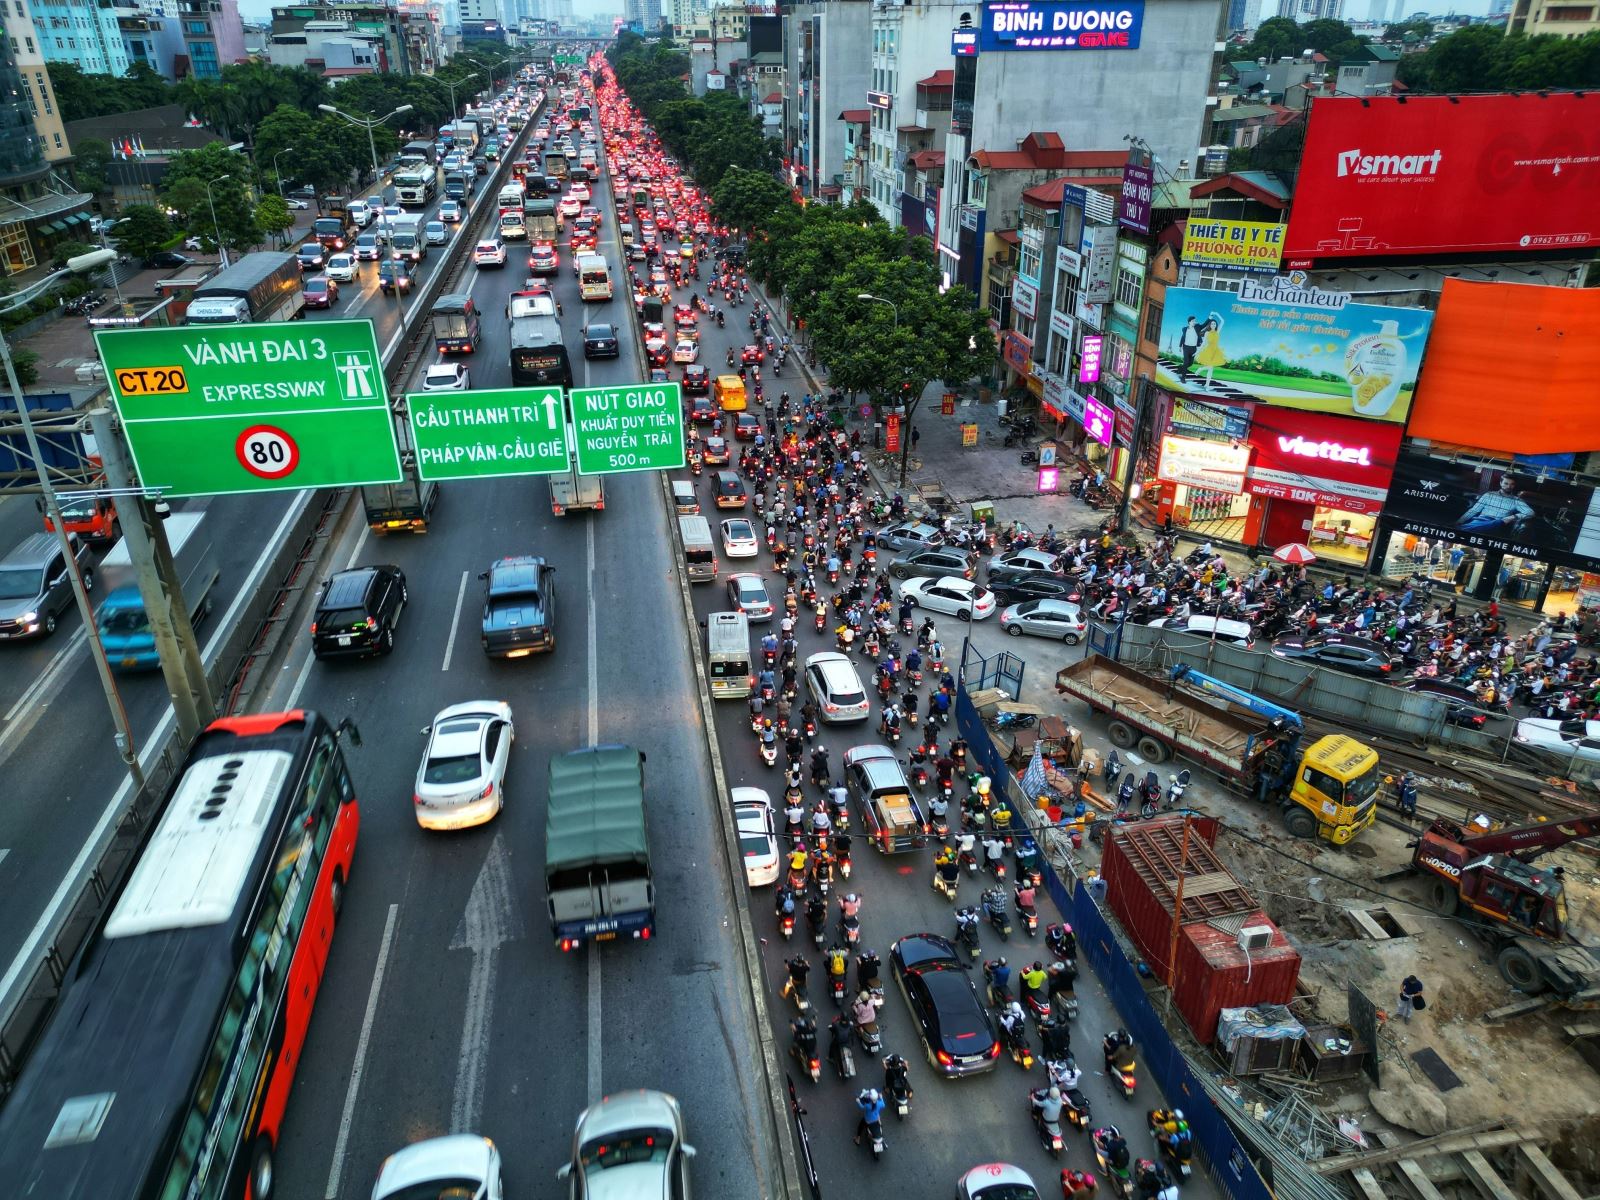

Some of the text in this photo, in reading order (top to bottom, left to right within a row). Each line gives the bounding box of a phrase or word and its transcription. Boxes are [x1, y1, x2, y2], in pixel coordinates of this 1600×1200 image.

[1190, 221, 1283, 243] THIẾT BỊ Y TẾ
[1186, 241, 1278, 259] PHƯƠNG HOA
[1241, 277, 1349, 308] Enchanteur
[183, 338, 327, 366] VÀNH ĐAI 3
[118, 370, 326, 402] CT.20 EXPRESSWAY
[586, 390, 666, 412] NÚT GIAO
[415, 401, 539, 428] CẦU THANH TRÌ
[580, 407, 675, 432] KHUẤT DUY TIẾN
[250, 440, 284, 464] 80
[587, 431, 672, 450] NGUYỄN TRÃI
[1278, 436, 1371, 466] viettel
[609, 454, 650, 467] 500 m
[1252, 486, 1286, 497] BUFFET
[1290, 488, 1317, 503] 10K
[1403, 488, 1447, 502] ARISTINO
[1404, 523, 1456, 539] ARISTINO
[1470, 536, 1484, 545] BE
[1487, 539, 1508, 550] THE
[1512, 545, 1538, 557] MAN
